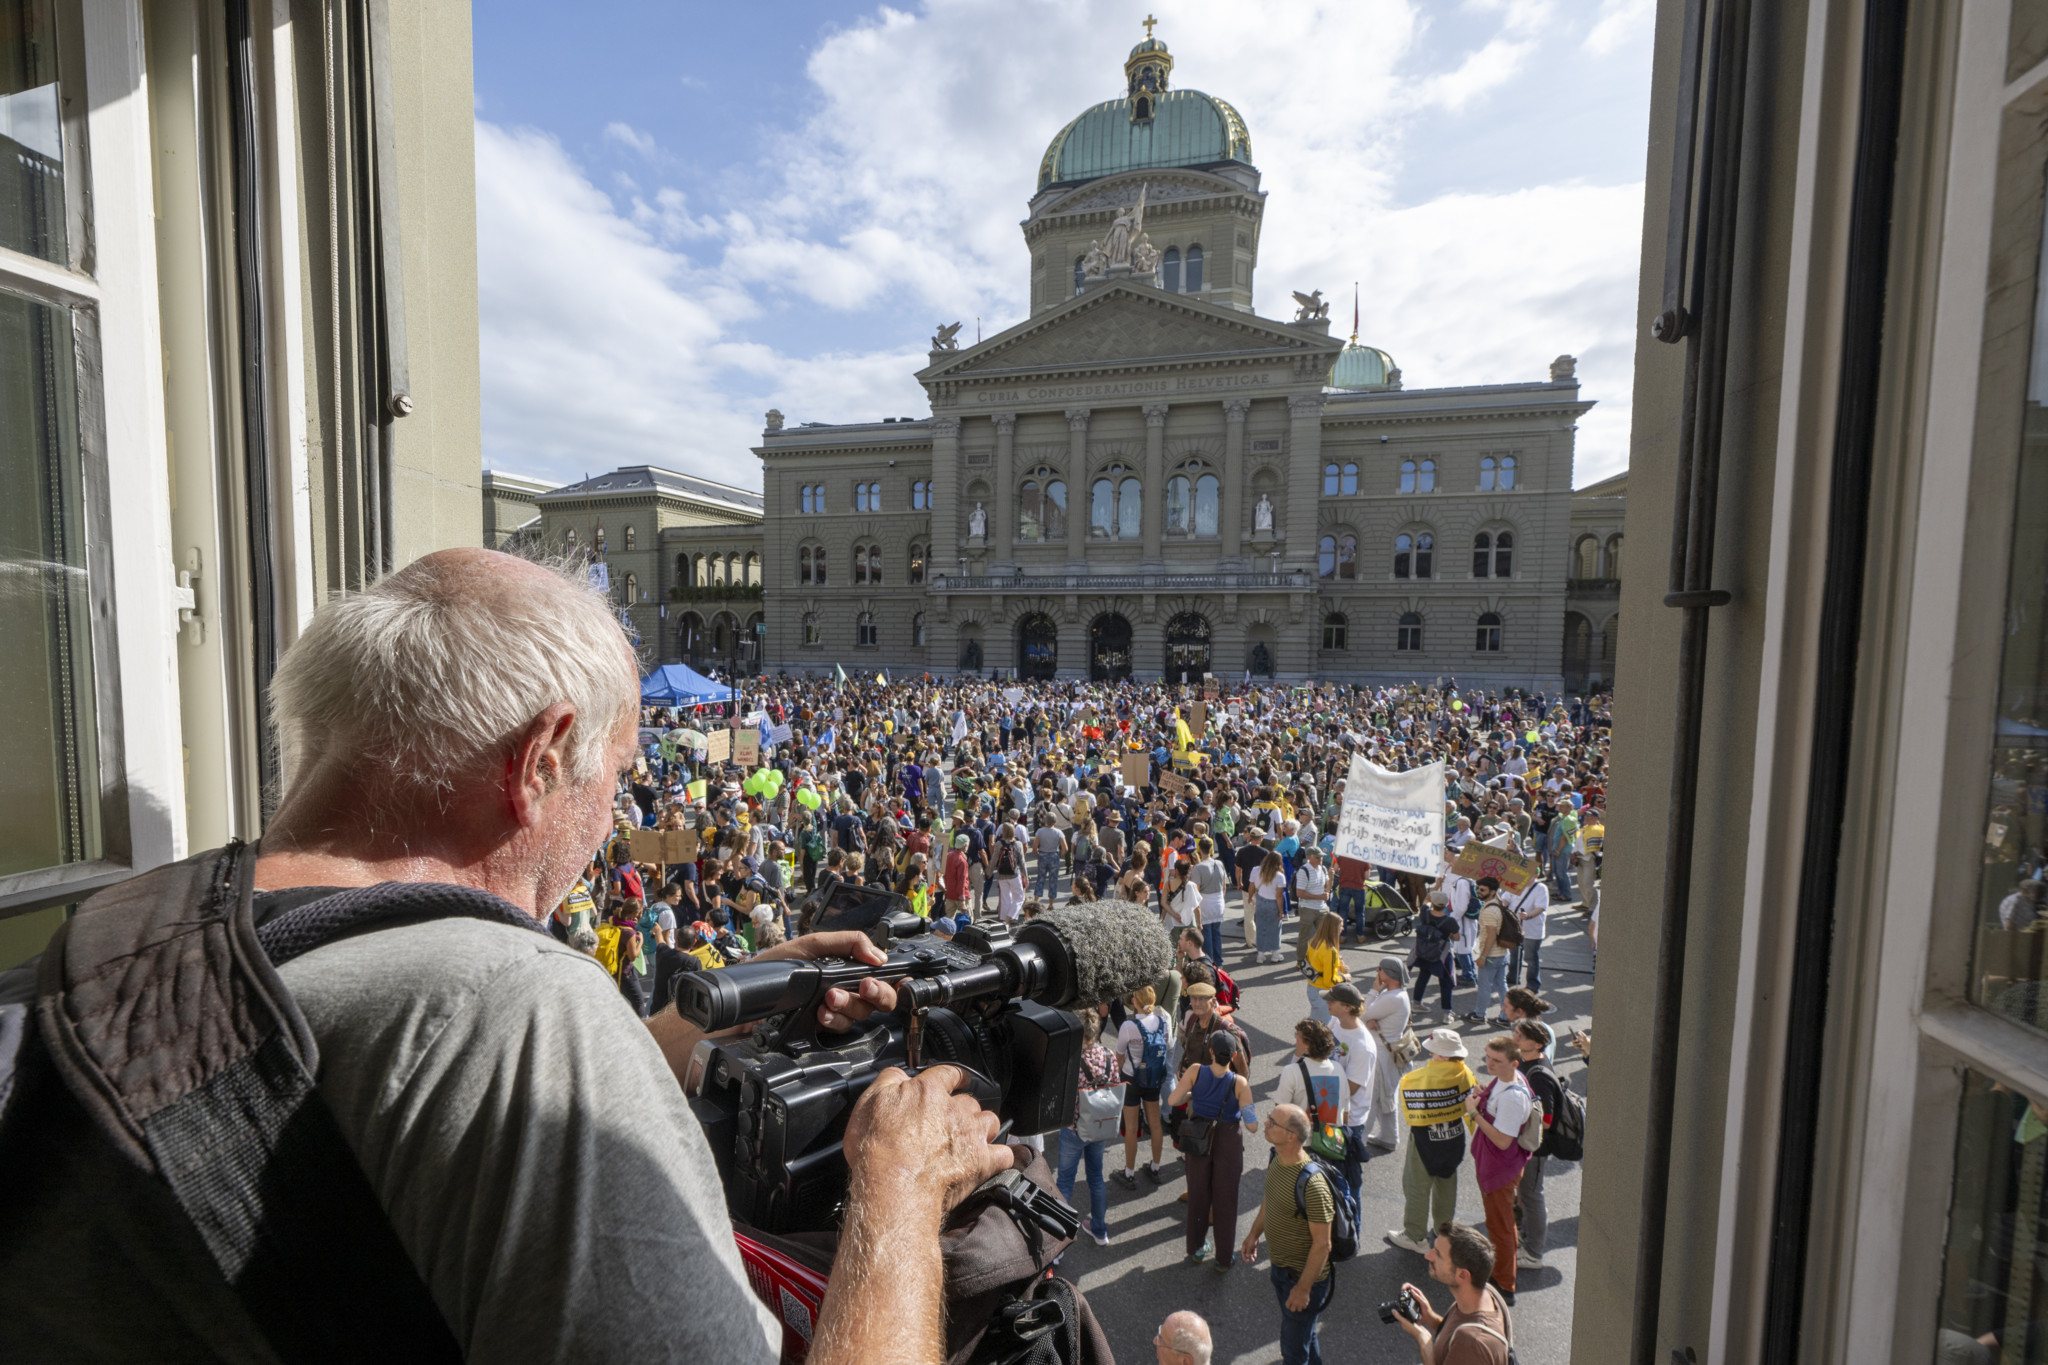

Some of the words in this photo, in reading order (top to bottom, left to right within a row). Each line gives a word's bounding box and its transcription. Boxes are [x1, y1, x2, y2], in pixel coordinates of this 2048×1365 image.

[1027, 381, 1168, 399] CONFOEDERATIONIS
[1176, 373, 1270, 390] HELVETICAE
[1460, 852, 1478, 863] IS
[1485, 846, 1528, 868] CLIMATE
[1404, 1090, 1424, 1098] Notre
[1425, 1088, 1458, 1097] nature,
[1407, 1101, 1425, 1109] notre
[1427, 1098, 1457, 1108] source
